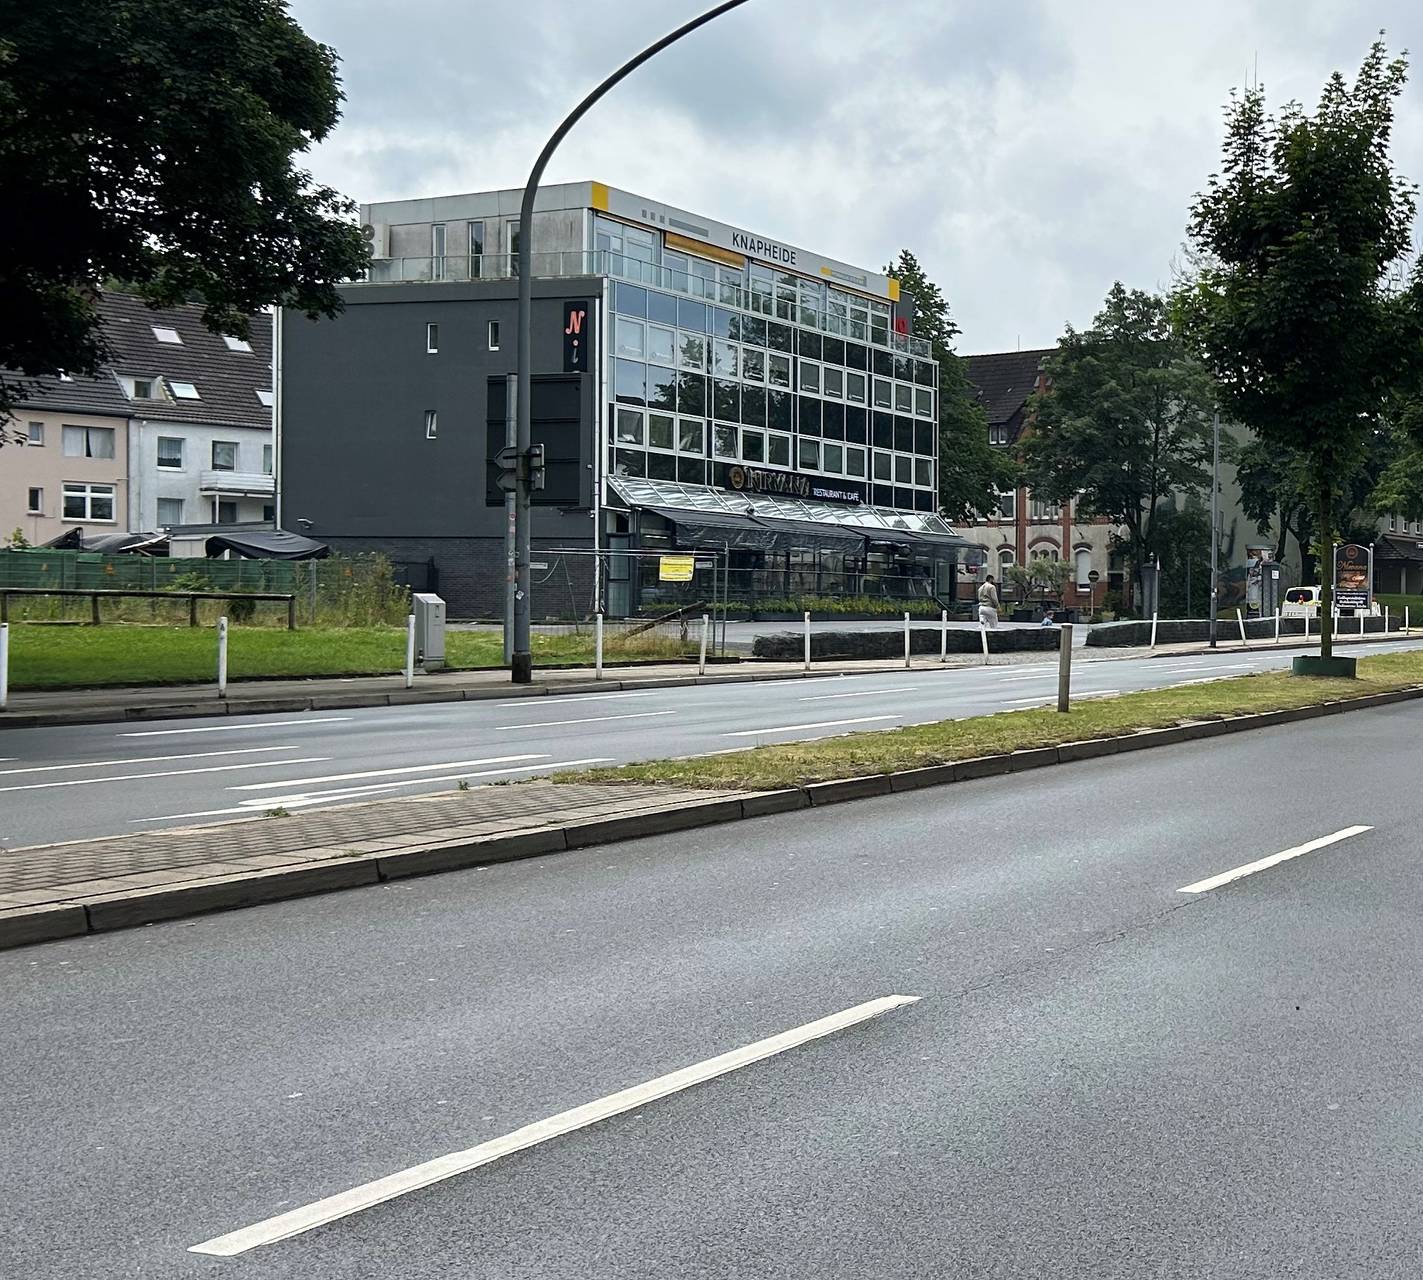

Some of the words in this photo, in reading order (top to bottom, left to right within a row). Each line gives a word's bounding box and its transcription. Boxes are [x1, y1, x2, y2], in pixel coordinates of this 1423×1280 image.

[732, 232, 797, 265] KNAPHEIDE
[743, 465, 810, 497] NIRVANA
[812, 487, 843, 500] RESTAURANT
